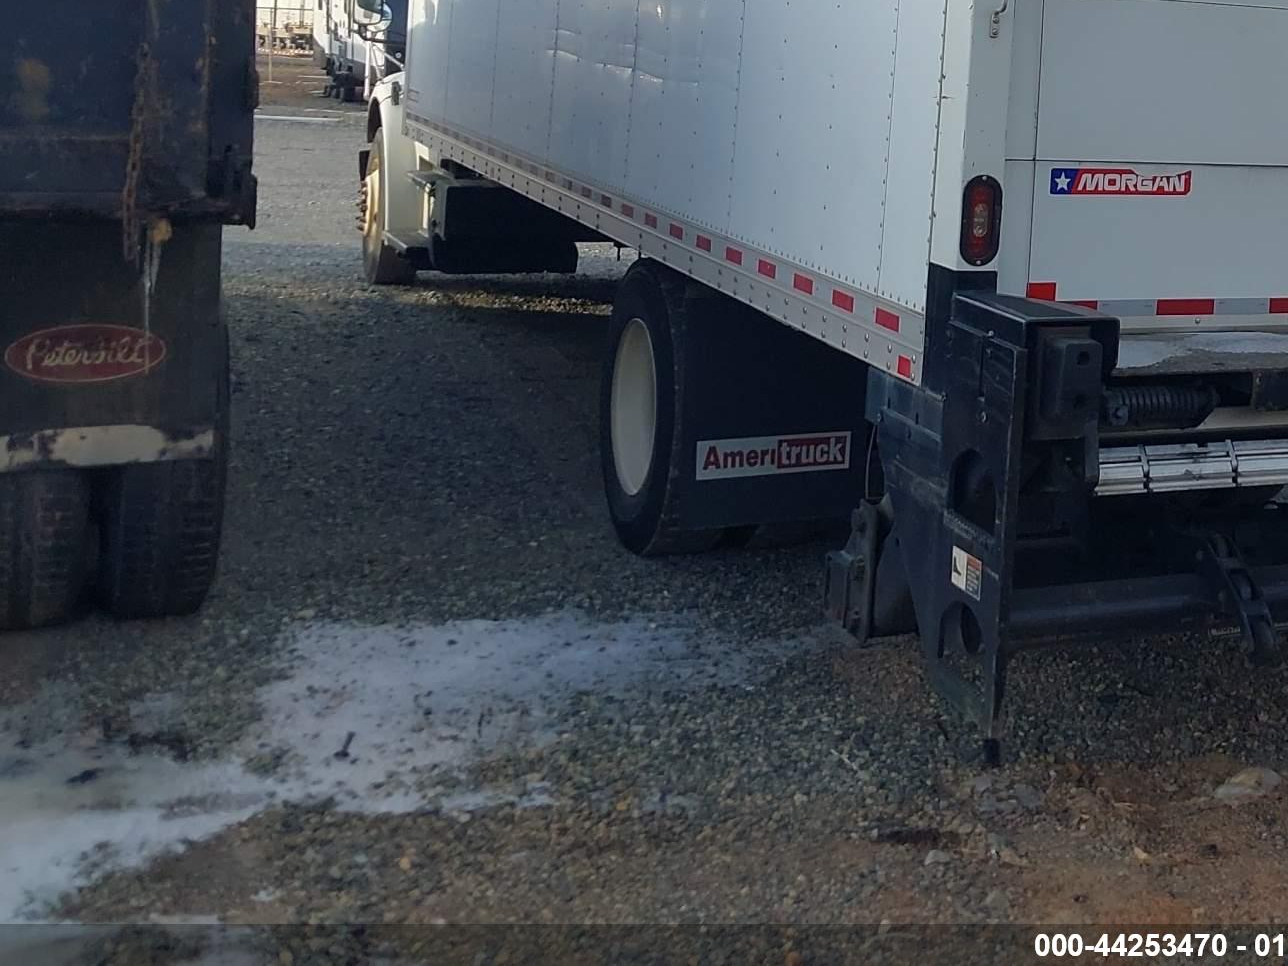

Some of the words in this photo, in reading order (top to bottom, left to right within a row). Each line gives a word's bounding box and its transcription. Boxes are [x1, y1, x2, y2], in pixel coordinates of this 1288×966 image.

[1077, 172, 1186, 192] MORGAN
[26, 335, 153, 370] Peterbilt
[702, 436, 844, 471] Ameritruck
